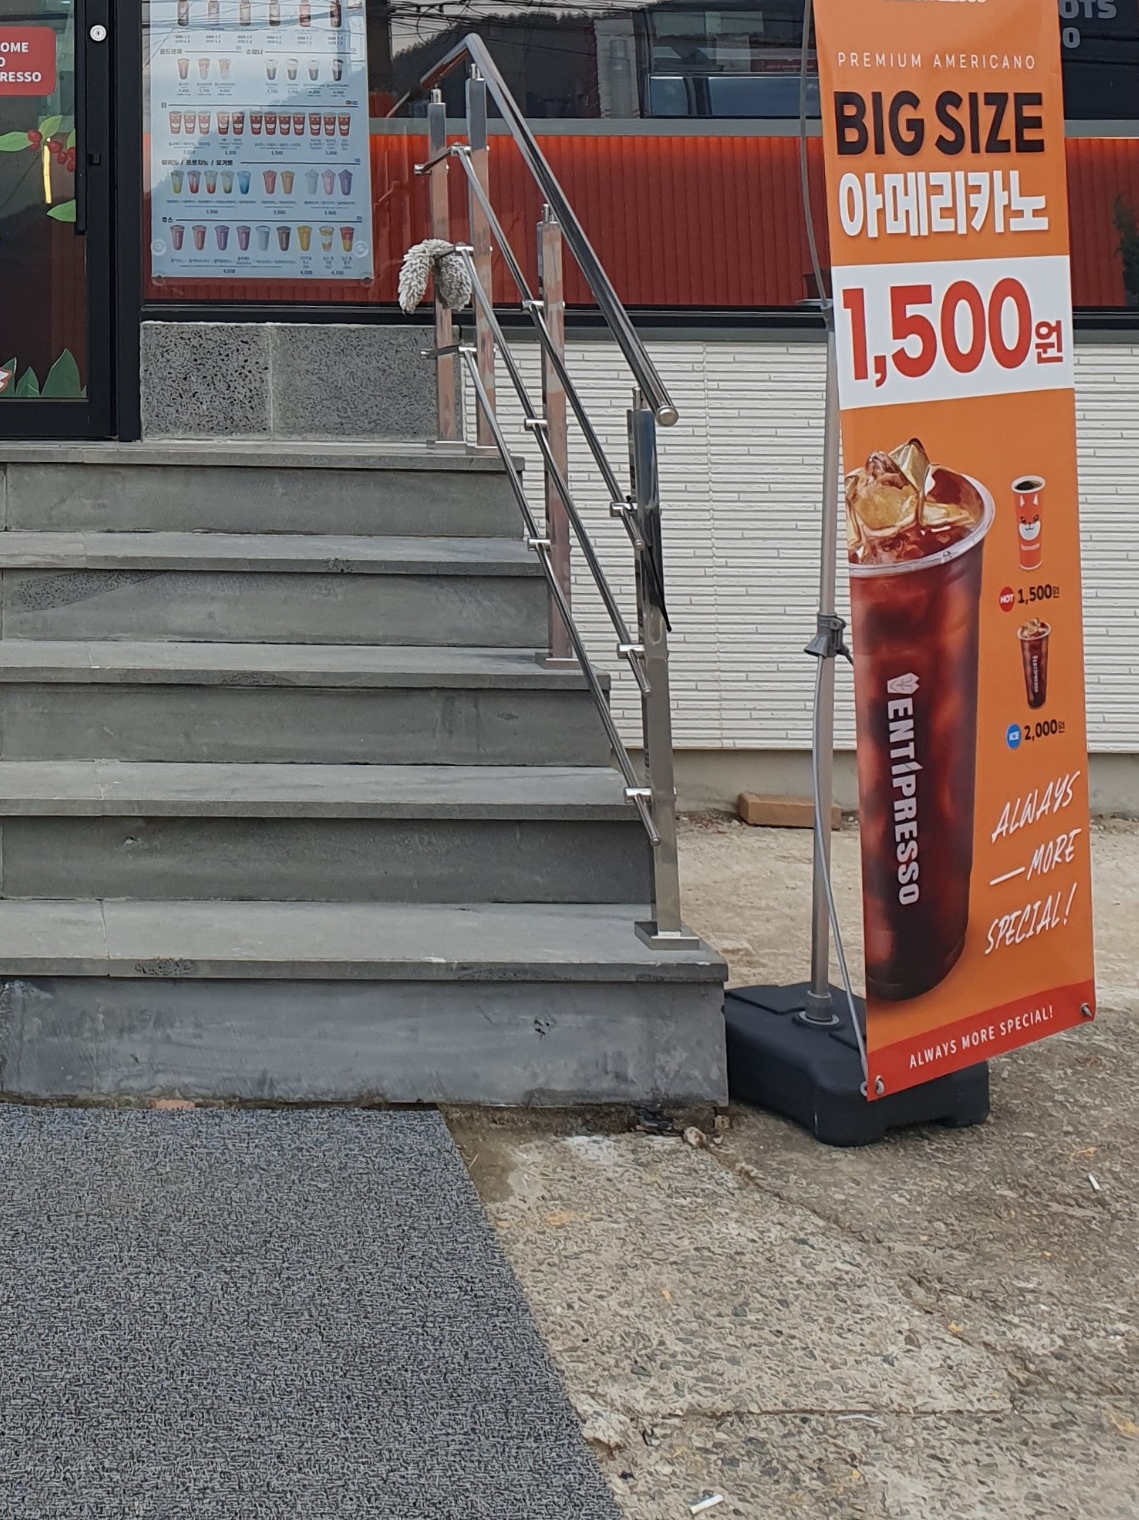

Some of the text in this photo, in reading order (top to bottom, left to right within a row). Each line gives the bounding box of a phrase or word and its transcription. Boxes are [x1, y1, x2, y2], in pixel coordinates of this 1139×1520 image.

[837, 52, 1036, 70] PREMIUM AMERICANO
[834, 90, 1045, 157] BIG SIZE
[838, 170, 1049, 239] 아메리카노
[1000, 593, 1015, 604] HOT
[1008, 731, 1020, 741] ICE
[991, 770, 1081, 844] ALWAYS
[984, 882, 1078, 955] SPECIAL!
[909, 1005, 1054, 1069] ALWAYS MORE SPECIAL!
